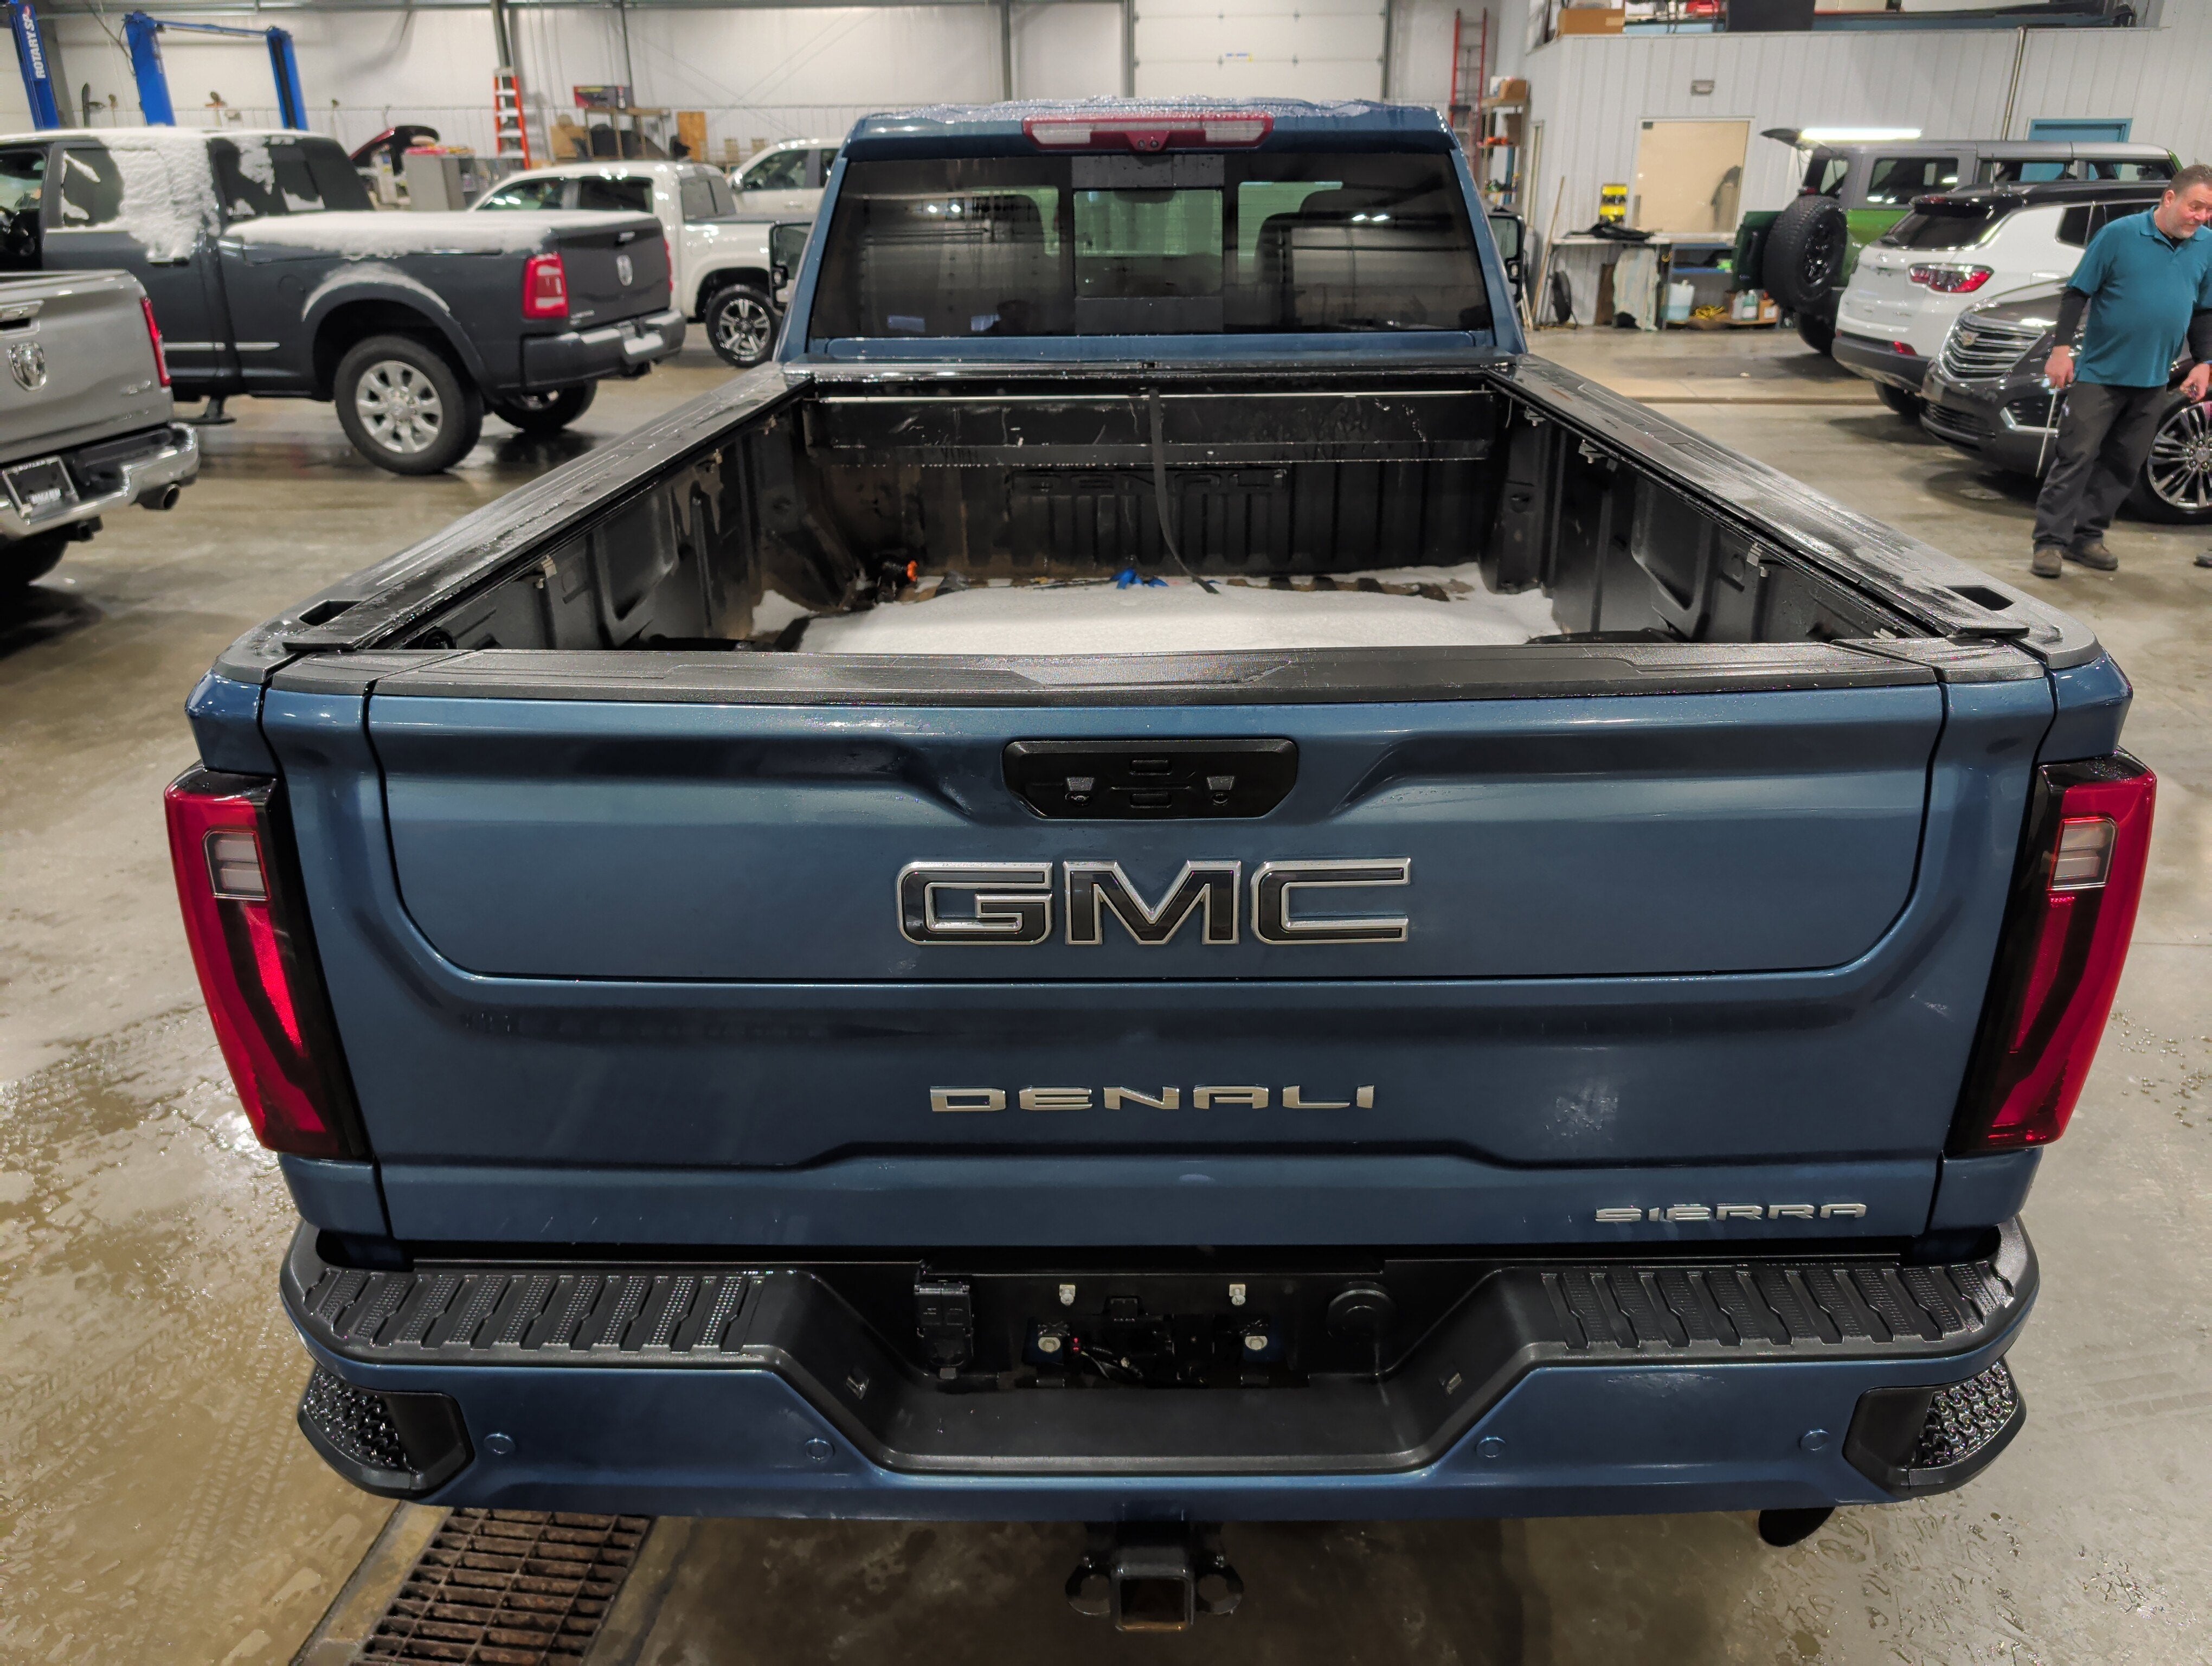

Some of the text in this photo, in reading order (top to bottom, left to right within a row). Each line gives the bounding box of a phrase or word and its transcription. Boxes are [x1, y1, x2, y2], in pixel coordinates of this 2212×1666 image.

[26, 31, 46, 78] ROTARY
[897, 858, 1411, 945] GMC
[930, 1085, 1374, 1111] DENALI
[1595, 1203, 1867, 1222] SIERRA
